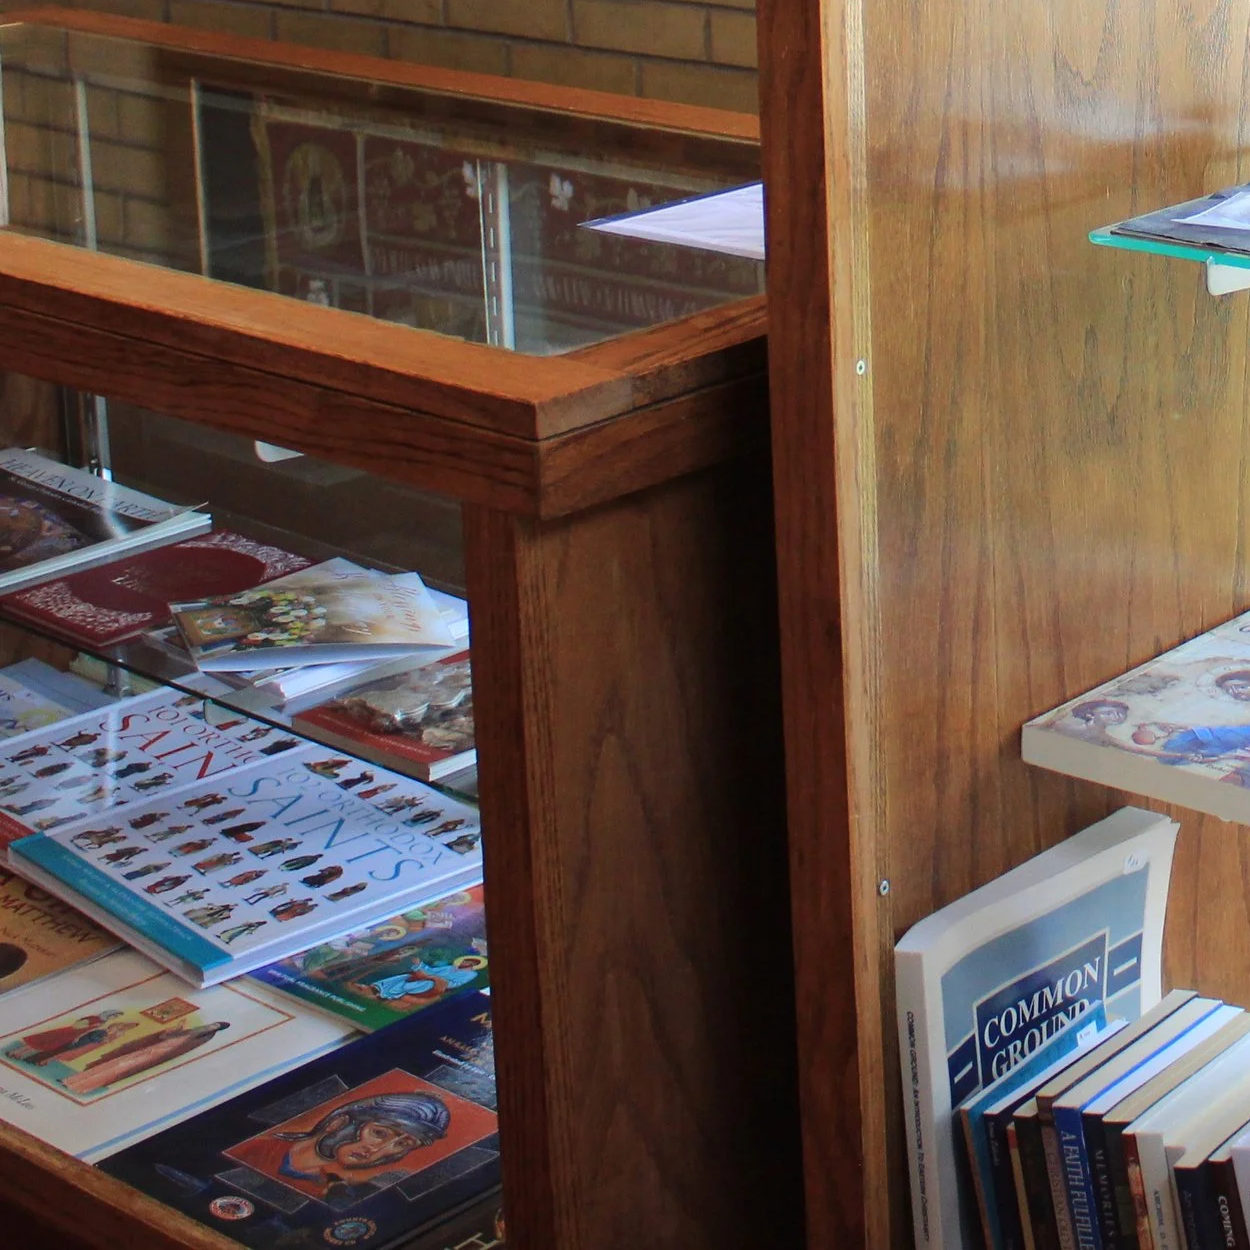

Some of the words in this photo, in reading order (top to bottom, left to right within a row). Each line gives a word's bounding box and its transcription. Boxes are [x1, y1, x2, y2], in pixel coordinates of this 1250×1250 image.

[229, 776, 425, 882] SAINTS
[316, 790, 446, 869] ORTHODOX
[1, 894, 98, 943] MATTHEW
[906, 1011, 916, 1049] COMMON
[983, 956, 1101, 1049] COMMON
[991, 998, 1090, 1081] GROUND
[1060, 1130, 1078, 1141] A
[1063, 1145, 1085, 1187] FAITH
[1094, 1149, 1116, 1238] MEMORIES
[1218, 1195, 1236, 1248] COMING
